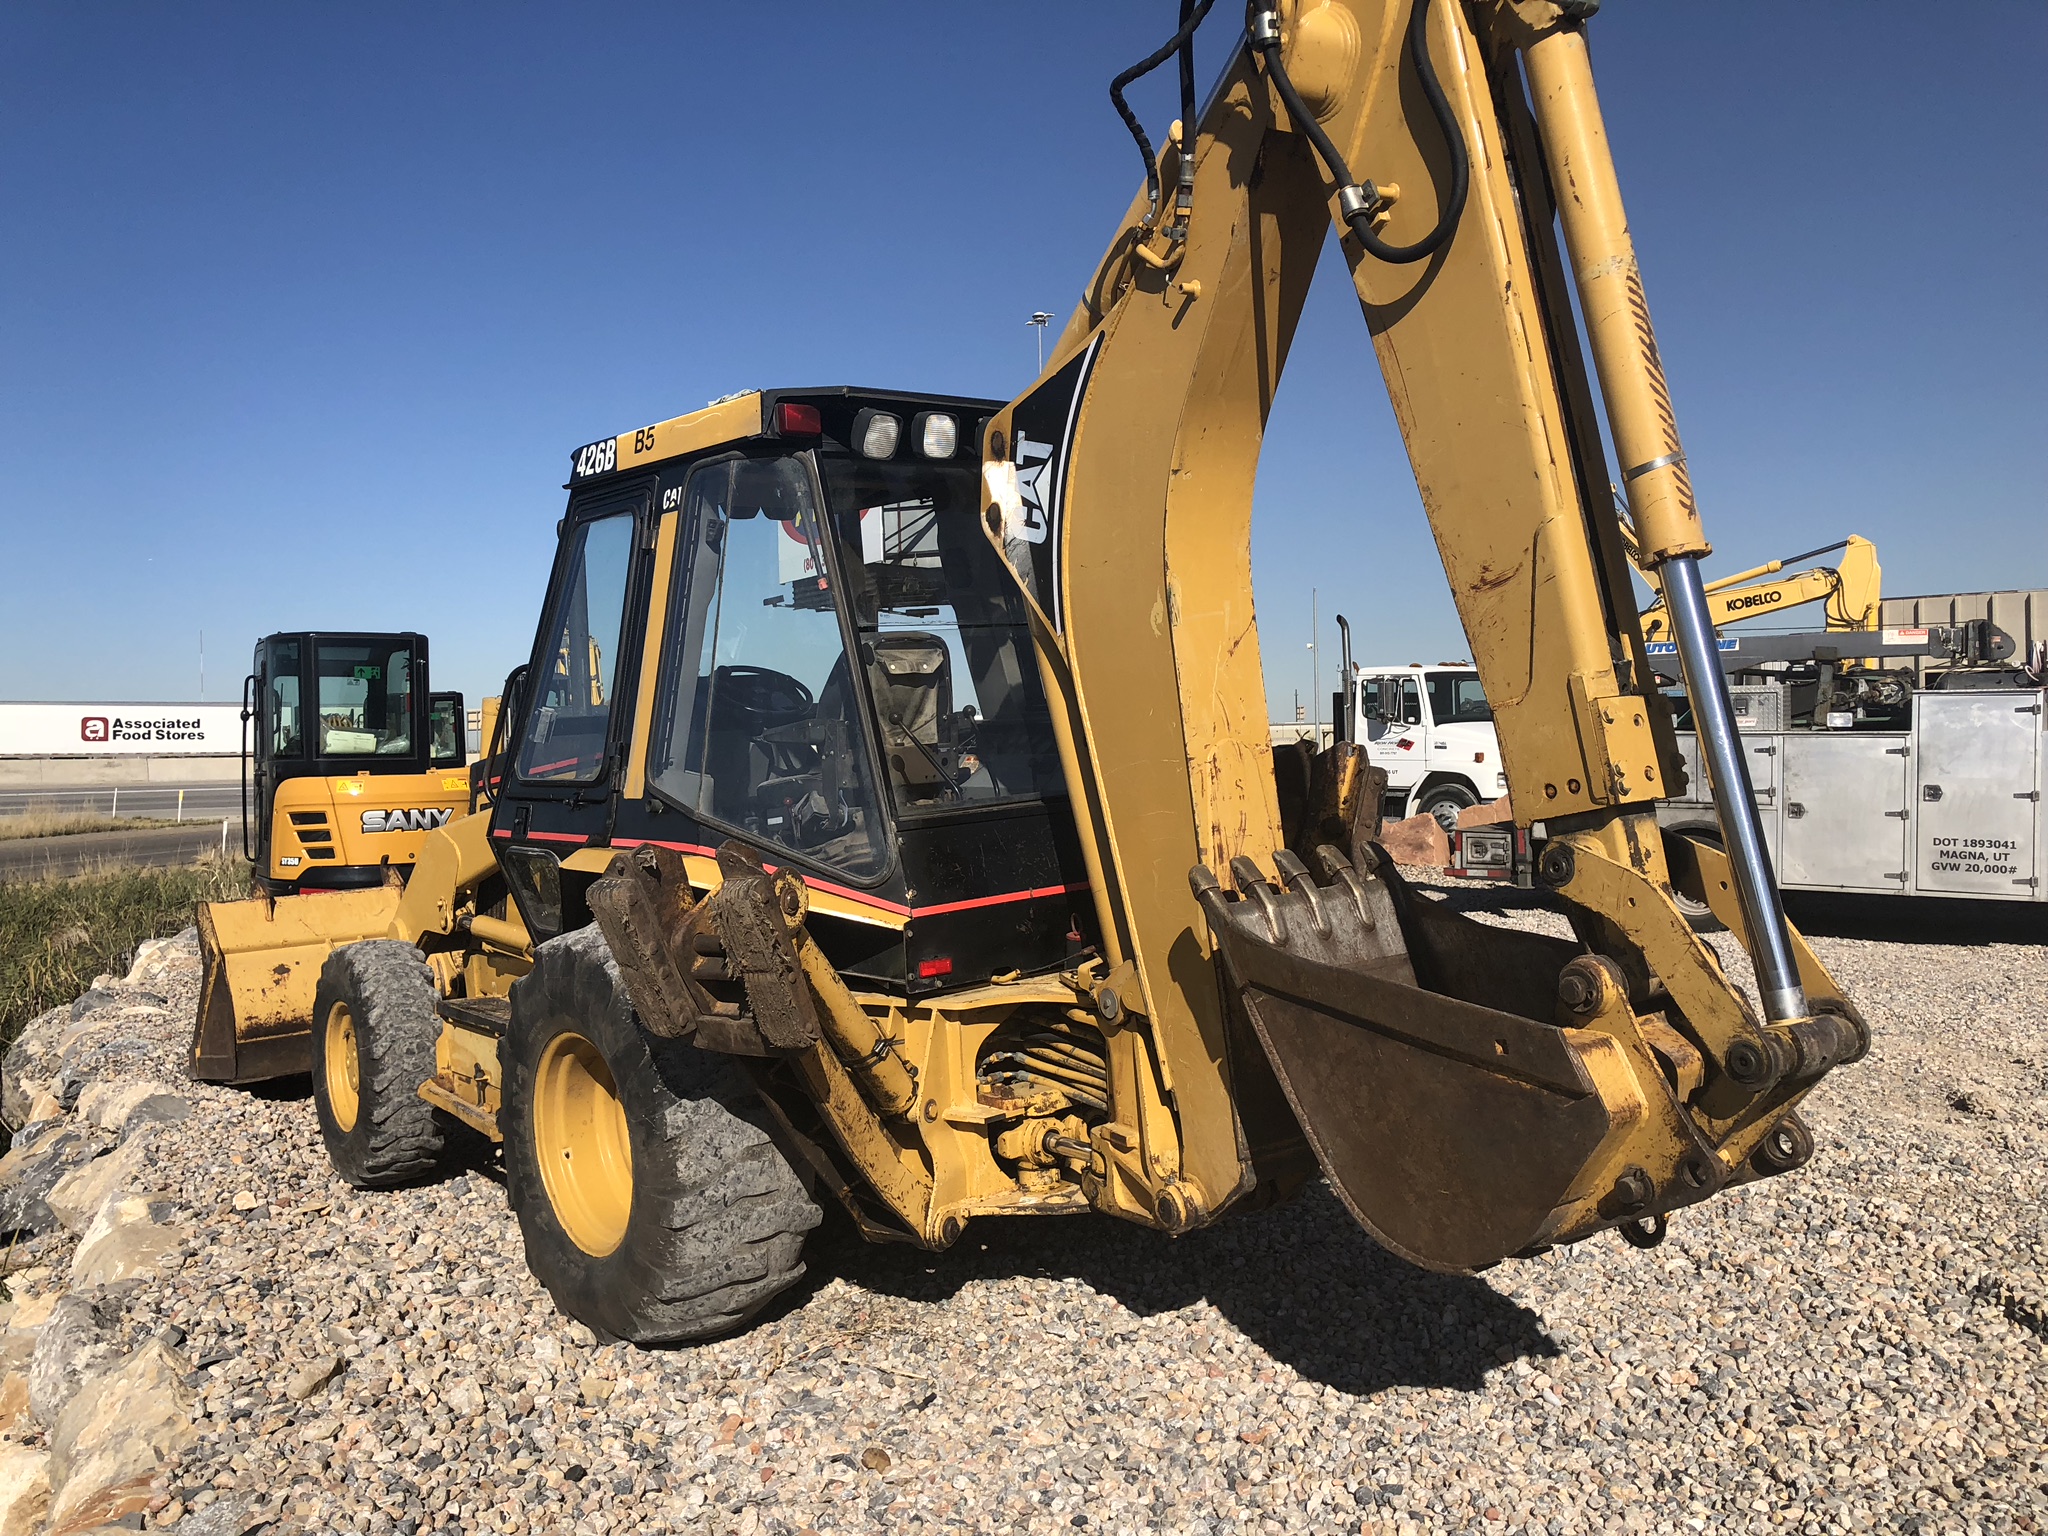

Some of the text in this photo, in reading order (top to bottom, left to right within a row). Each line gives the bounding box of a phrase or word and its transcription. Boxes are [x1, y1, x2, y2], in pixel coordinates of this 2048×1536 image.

[634, 426, 655, 454] B5
[576, 438, 616, 477] 426B
[662, 486, 682, 510] CAT
[1012, 430, 1053, 544] CAT
[1621, 537, 1640, 561] OBELCO
[1726, 590, 1782, 612] KOBELCO
[1645, 642, 1677, 654] UTO
[112, 718, 200, 729] Associated
[112, 729, 205, 740] Food Stores
[361, 808, 454, 834] SANY
[1933, 837, 2017, 849] DOT 1893041
[1940, 849, 2010, 862] MAGNA, UT
[1931, 861, 2018, 874] GVW 20,000#
